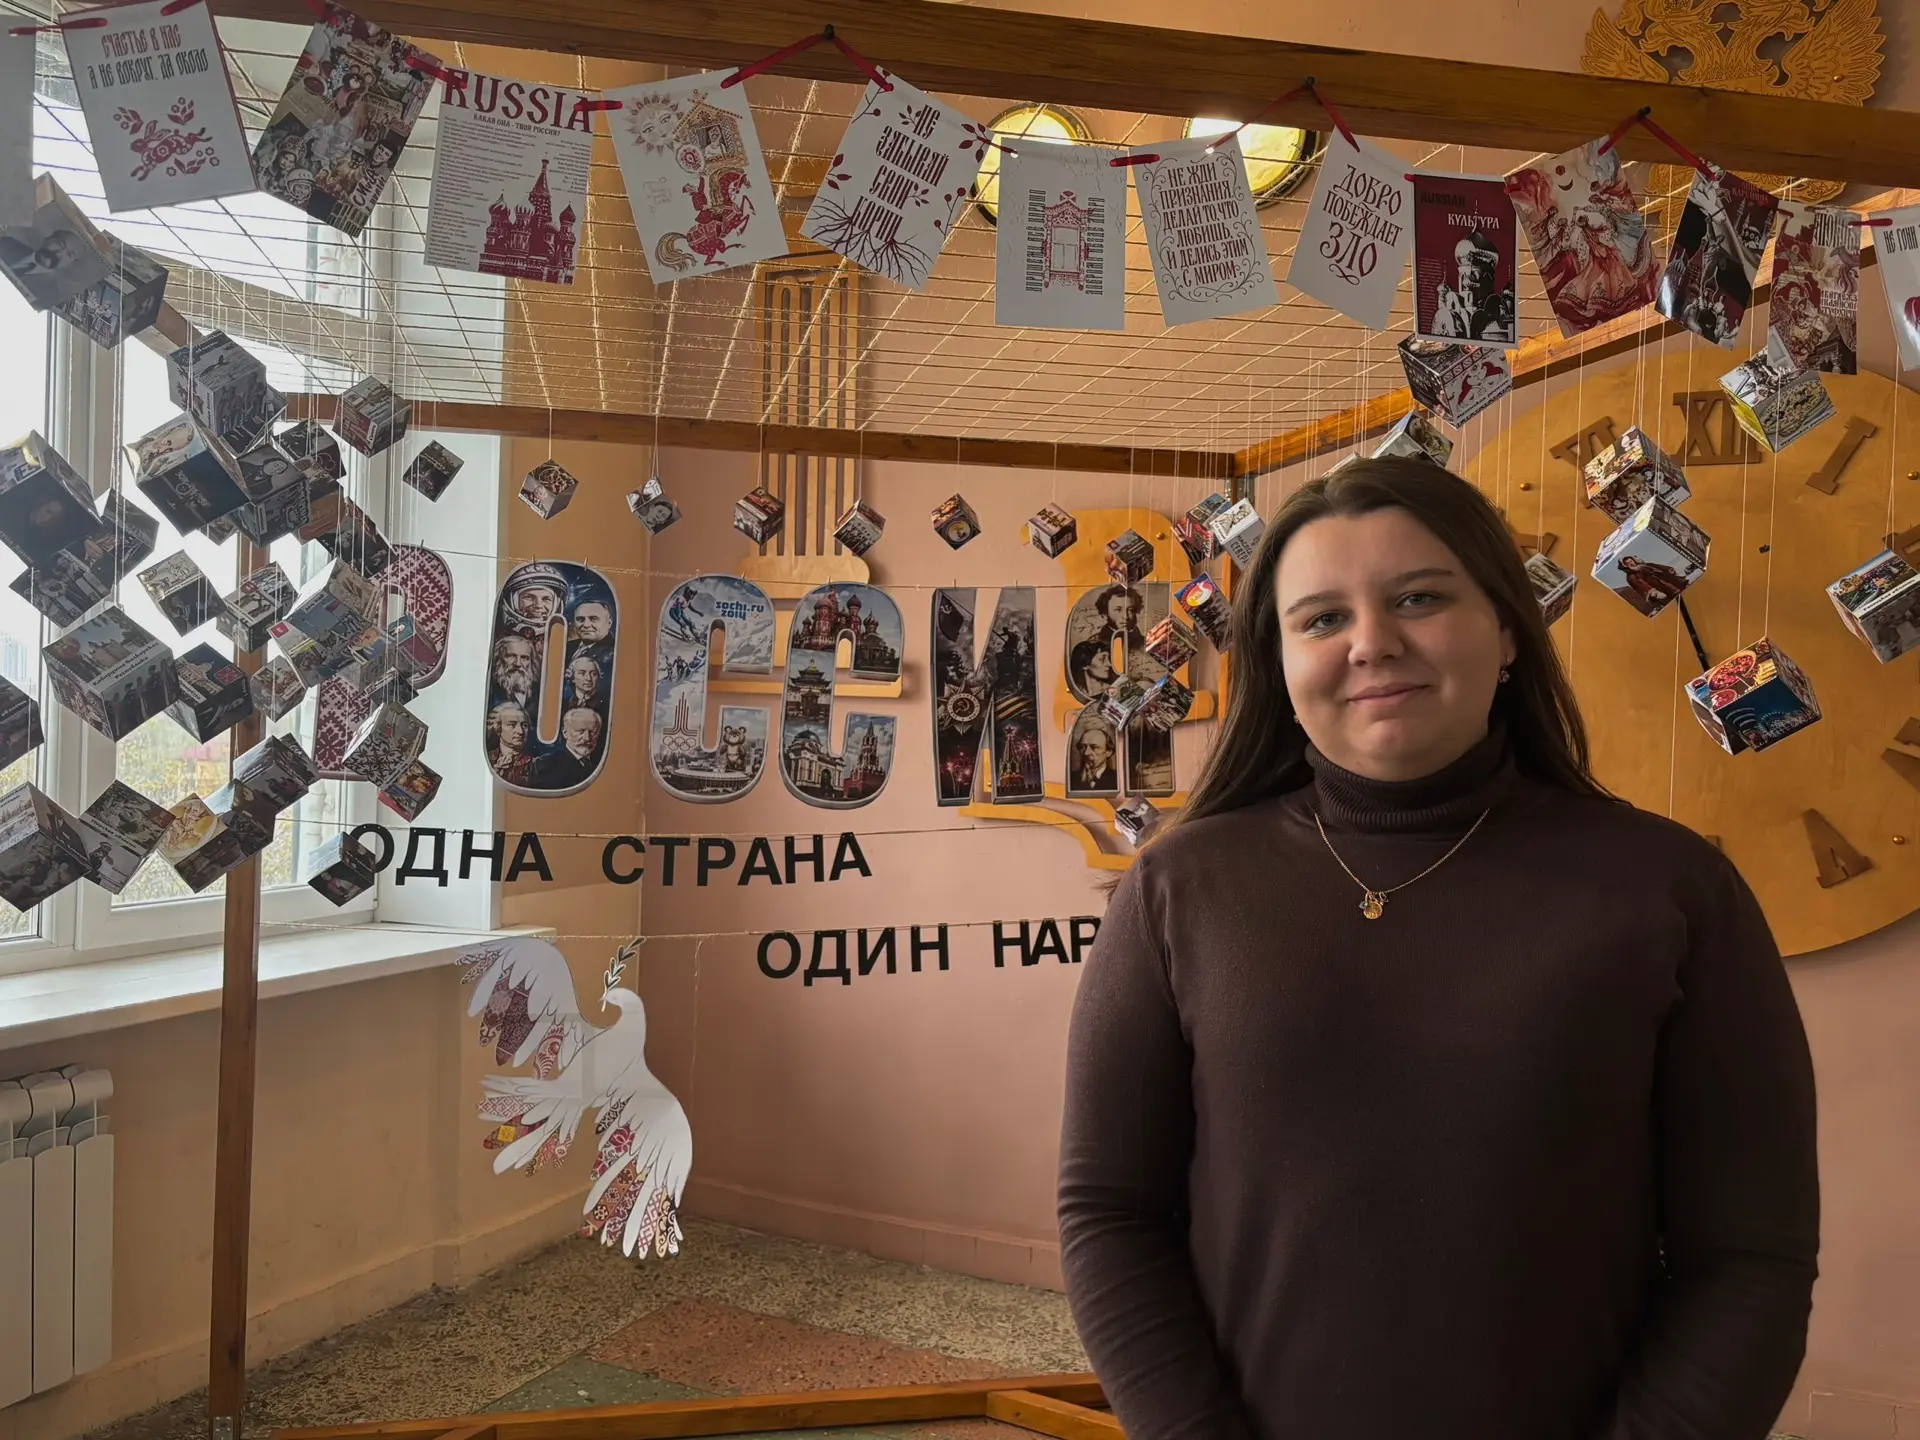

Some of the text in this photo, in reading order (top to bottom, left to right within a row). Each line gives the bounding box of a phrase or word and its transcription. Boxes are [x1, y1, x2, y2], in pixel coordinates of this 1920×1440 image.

[101, 24, 182, 59] СЧАСТЬЕ В НАС
[87, 65, 98, 89] А
[98, 63, 115, 88] НЕ
[157, 54, 175, 80] ДА
[175, 48, 209, 75] ОКОЛО
[441, 67, 593, 134] RUSSIA
[473, 114, 497, 125] КАКАЯ
[496, 118, 511, 128] ОНА
[515, 122, 532, 132] ТВОЯ
[533, 126, 561, 138] РОССИЯ?
[913, 104, 940, 139] НЕ
[876, 125, 949, 187] ЗАБЫВАЙ
[1167, 162, 1218, 188] НЕ ЖДИ
[869, 165, 915, 210] СВОИ
[1028, 189, 1046, 223] ХОРОШО
[1332, 163, 1402, 216] ДОБРО
[852, 194, 904, 243] КОРНИ
[1162, 203, 1202, 236] ДЕЛАЙ
[1219, 200, 1239, 220] ЧТО
[1322, 189, 1403, 248] ПОБЕЖДАЕТ
[1447, 213, 1500, 230] КУЛЬТУРА
[1166, 238, 1249, 270] И ДЕЛИСЬ ЭТИМ
[1319, 220, 1377, 277] ЗЛО
[1883, 230, 1897, 254] НЕ
[1896, 226, 1918, 252] ГОНИ
[1026, 245, 1044, 292] ХОРОШЕМУ
[1085, 257, 1104, 295] ДОБРОМУ
[1182, 261, 1237, 288] С МИРОМ
[715, 601, 764, 613] sochi.ru
[350, 823, 553, 888] ОДНА
[601, 831, 873, 886] СТРАНА
[757, 923, 950, 987] ОДИН
[993, 915, 1101, 968] НАР
